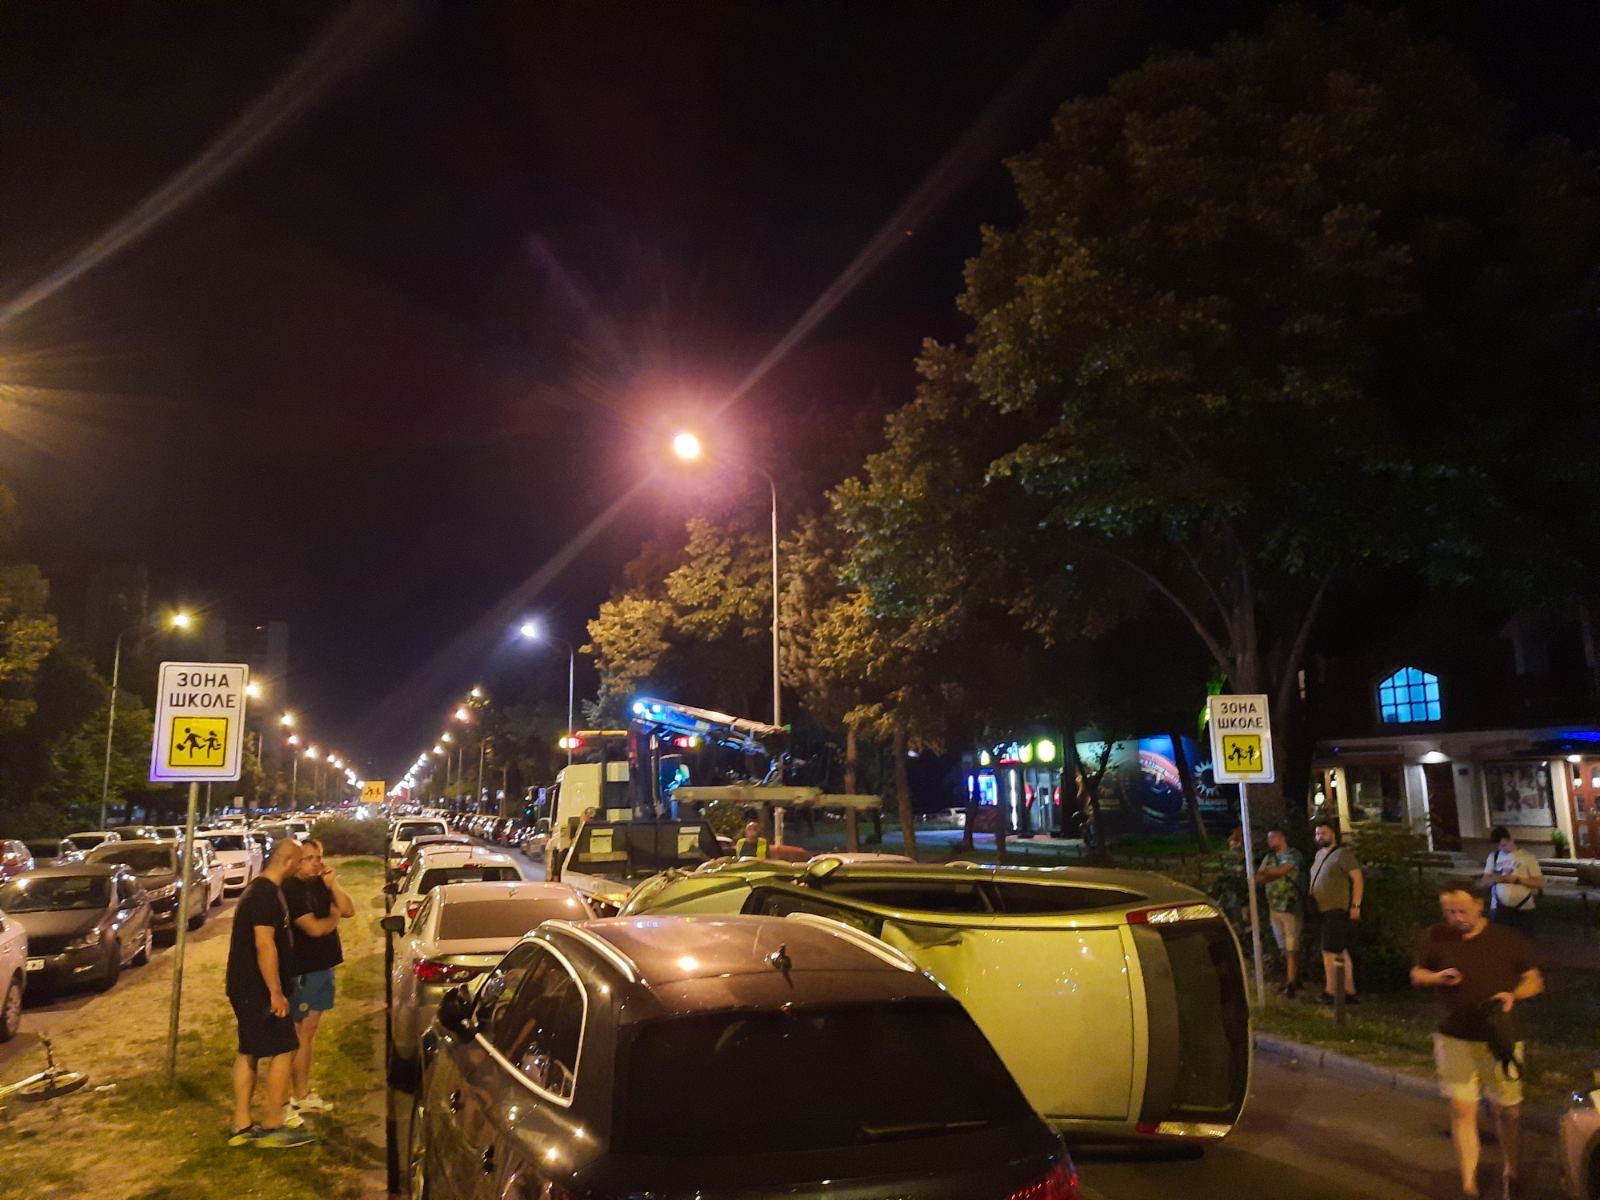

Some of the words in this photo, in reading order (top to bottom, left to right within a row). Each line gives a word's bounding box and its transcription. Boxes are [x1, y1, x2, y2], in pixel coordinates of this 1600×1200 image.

[177, 672, 229, 688] ЗОНА
[169, 692, 237, 708] ШКОЛЕ
[1220, 702, 1257, 714] ЗОНА
[1217, 717, 1263, 729] ШКОЛЕ
